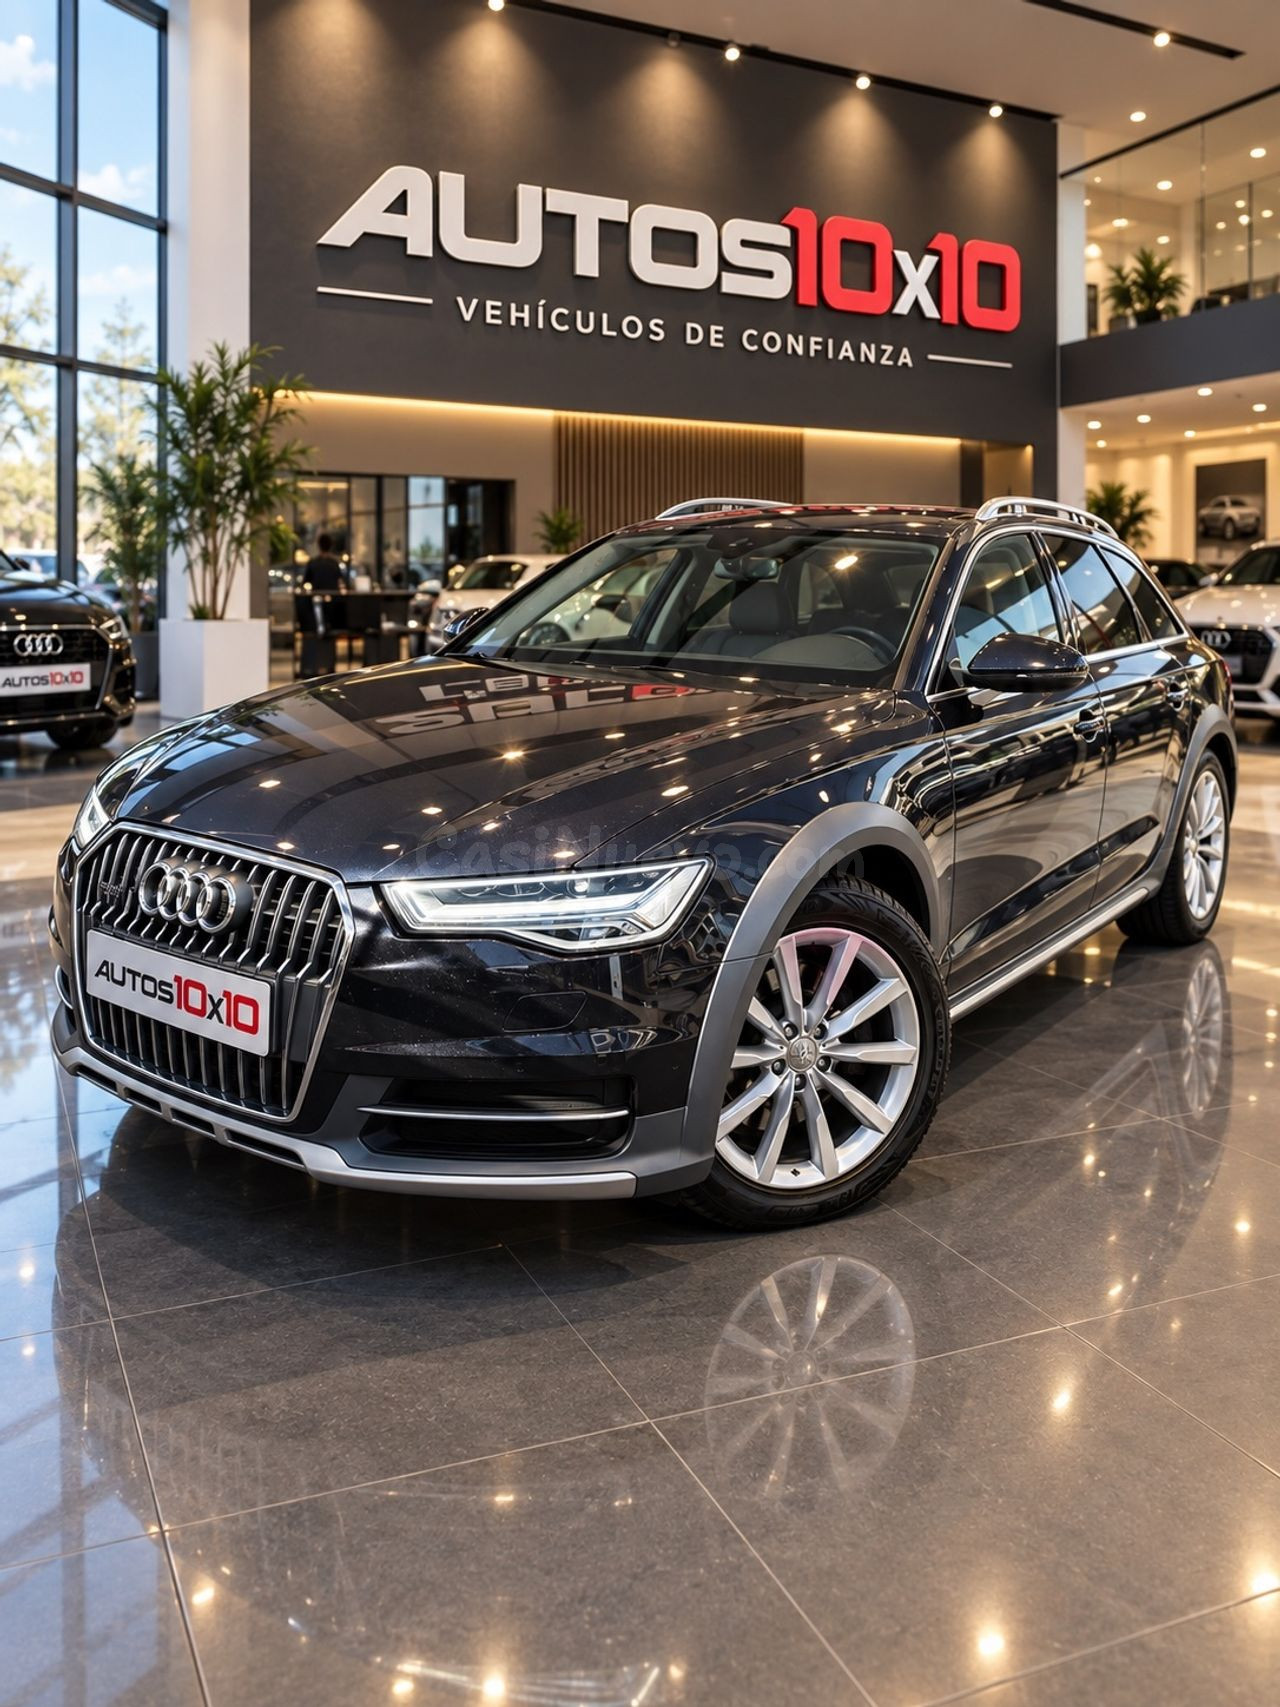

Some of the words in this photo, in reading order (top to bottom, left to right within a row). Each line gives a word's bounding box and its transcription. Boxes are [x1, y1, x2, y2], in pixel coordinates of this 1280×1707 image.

[317, 165, 1022, 332] AUTOS10x10
[456, 296, 666, 341] VEHÍCULOS
[685, 324, 725, 347] DE
[741, 329, 913, 367] CONFIANZA
[2, 671, 84, 688] AUTOS10x10
[94, 959, 260, 1036] AUTOS10x10
